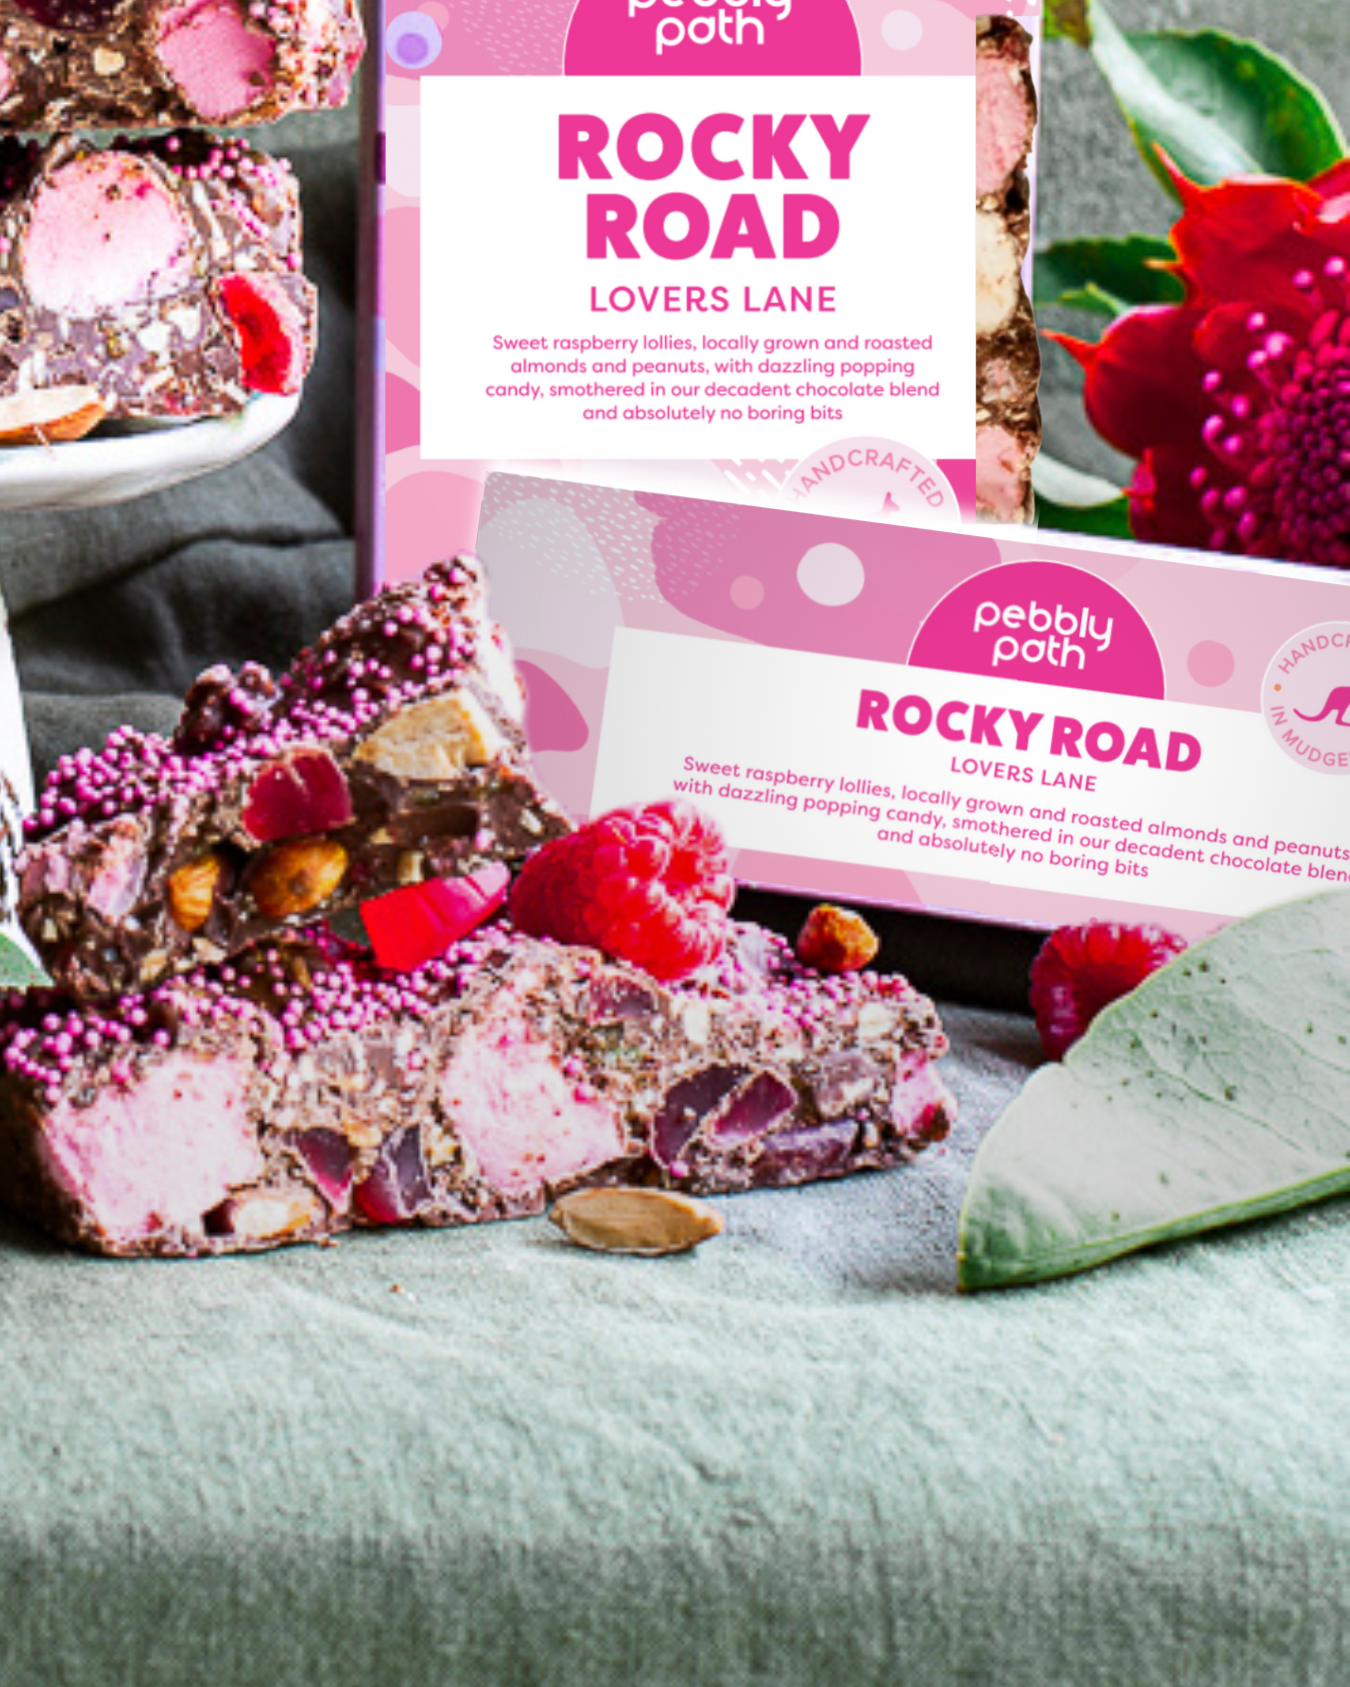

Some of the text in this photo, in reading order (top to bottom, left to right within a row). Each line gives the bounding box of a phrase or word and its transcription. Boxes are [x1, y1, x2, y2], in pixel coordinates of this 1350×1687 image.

[656, 9, 764, 55] path
[558, 112, 871, 181] ROCKY
[586, 191, 841, 261] ROAD
[590, 285, 836, 313] LOVERS LANE
[493, 335, 933, 355] Sweet raspberry lollies, locally grown and roasted
[511, 358, 915, 378] almonds and peanuts, with dazzling popping
[486, 381, 940, 401] candy, smothered in our decadent chocolate blend
[583, 405, 843, 424] and absolutely no boring bits
[787, 448, 945, 508] HANDCRAFTED
[973, 600, 1114, 652] pebbly
[992, 635, 1086, 670] path
[856, 688, 1202, 772] ROCKY ROAD
[1270, 705, 1288, 726] IN
[950, 756, 1097, 792] LOVERS LANE
[683, 756, 741, 778] Sweet
[745, 767, 835, 794] raspberry
[839, 777, 896, 801] lollies,
[901, 785, 962, 811] locally
[965, 798, 1024, 817] grown
[1028, 807, 1067, 823] and
[1071, 813, 1144, 833] roasted
[1147, 821, 1227, 845] almonds
[1232, 835, 1270, 850] and
[673, 777, 1350, 883] with dazzling popping candy, smothered in our decadent chocolate blen
[876, 828, 1149, 878] and absolutely no boring bits
